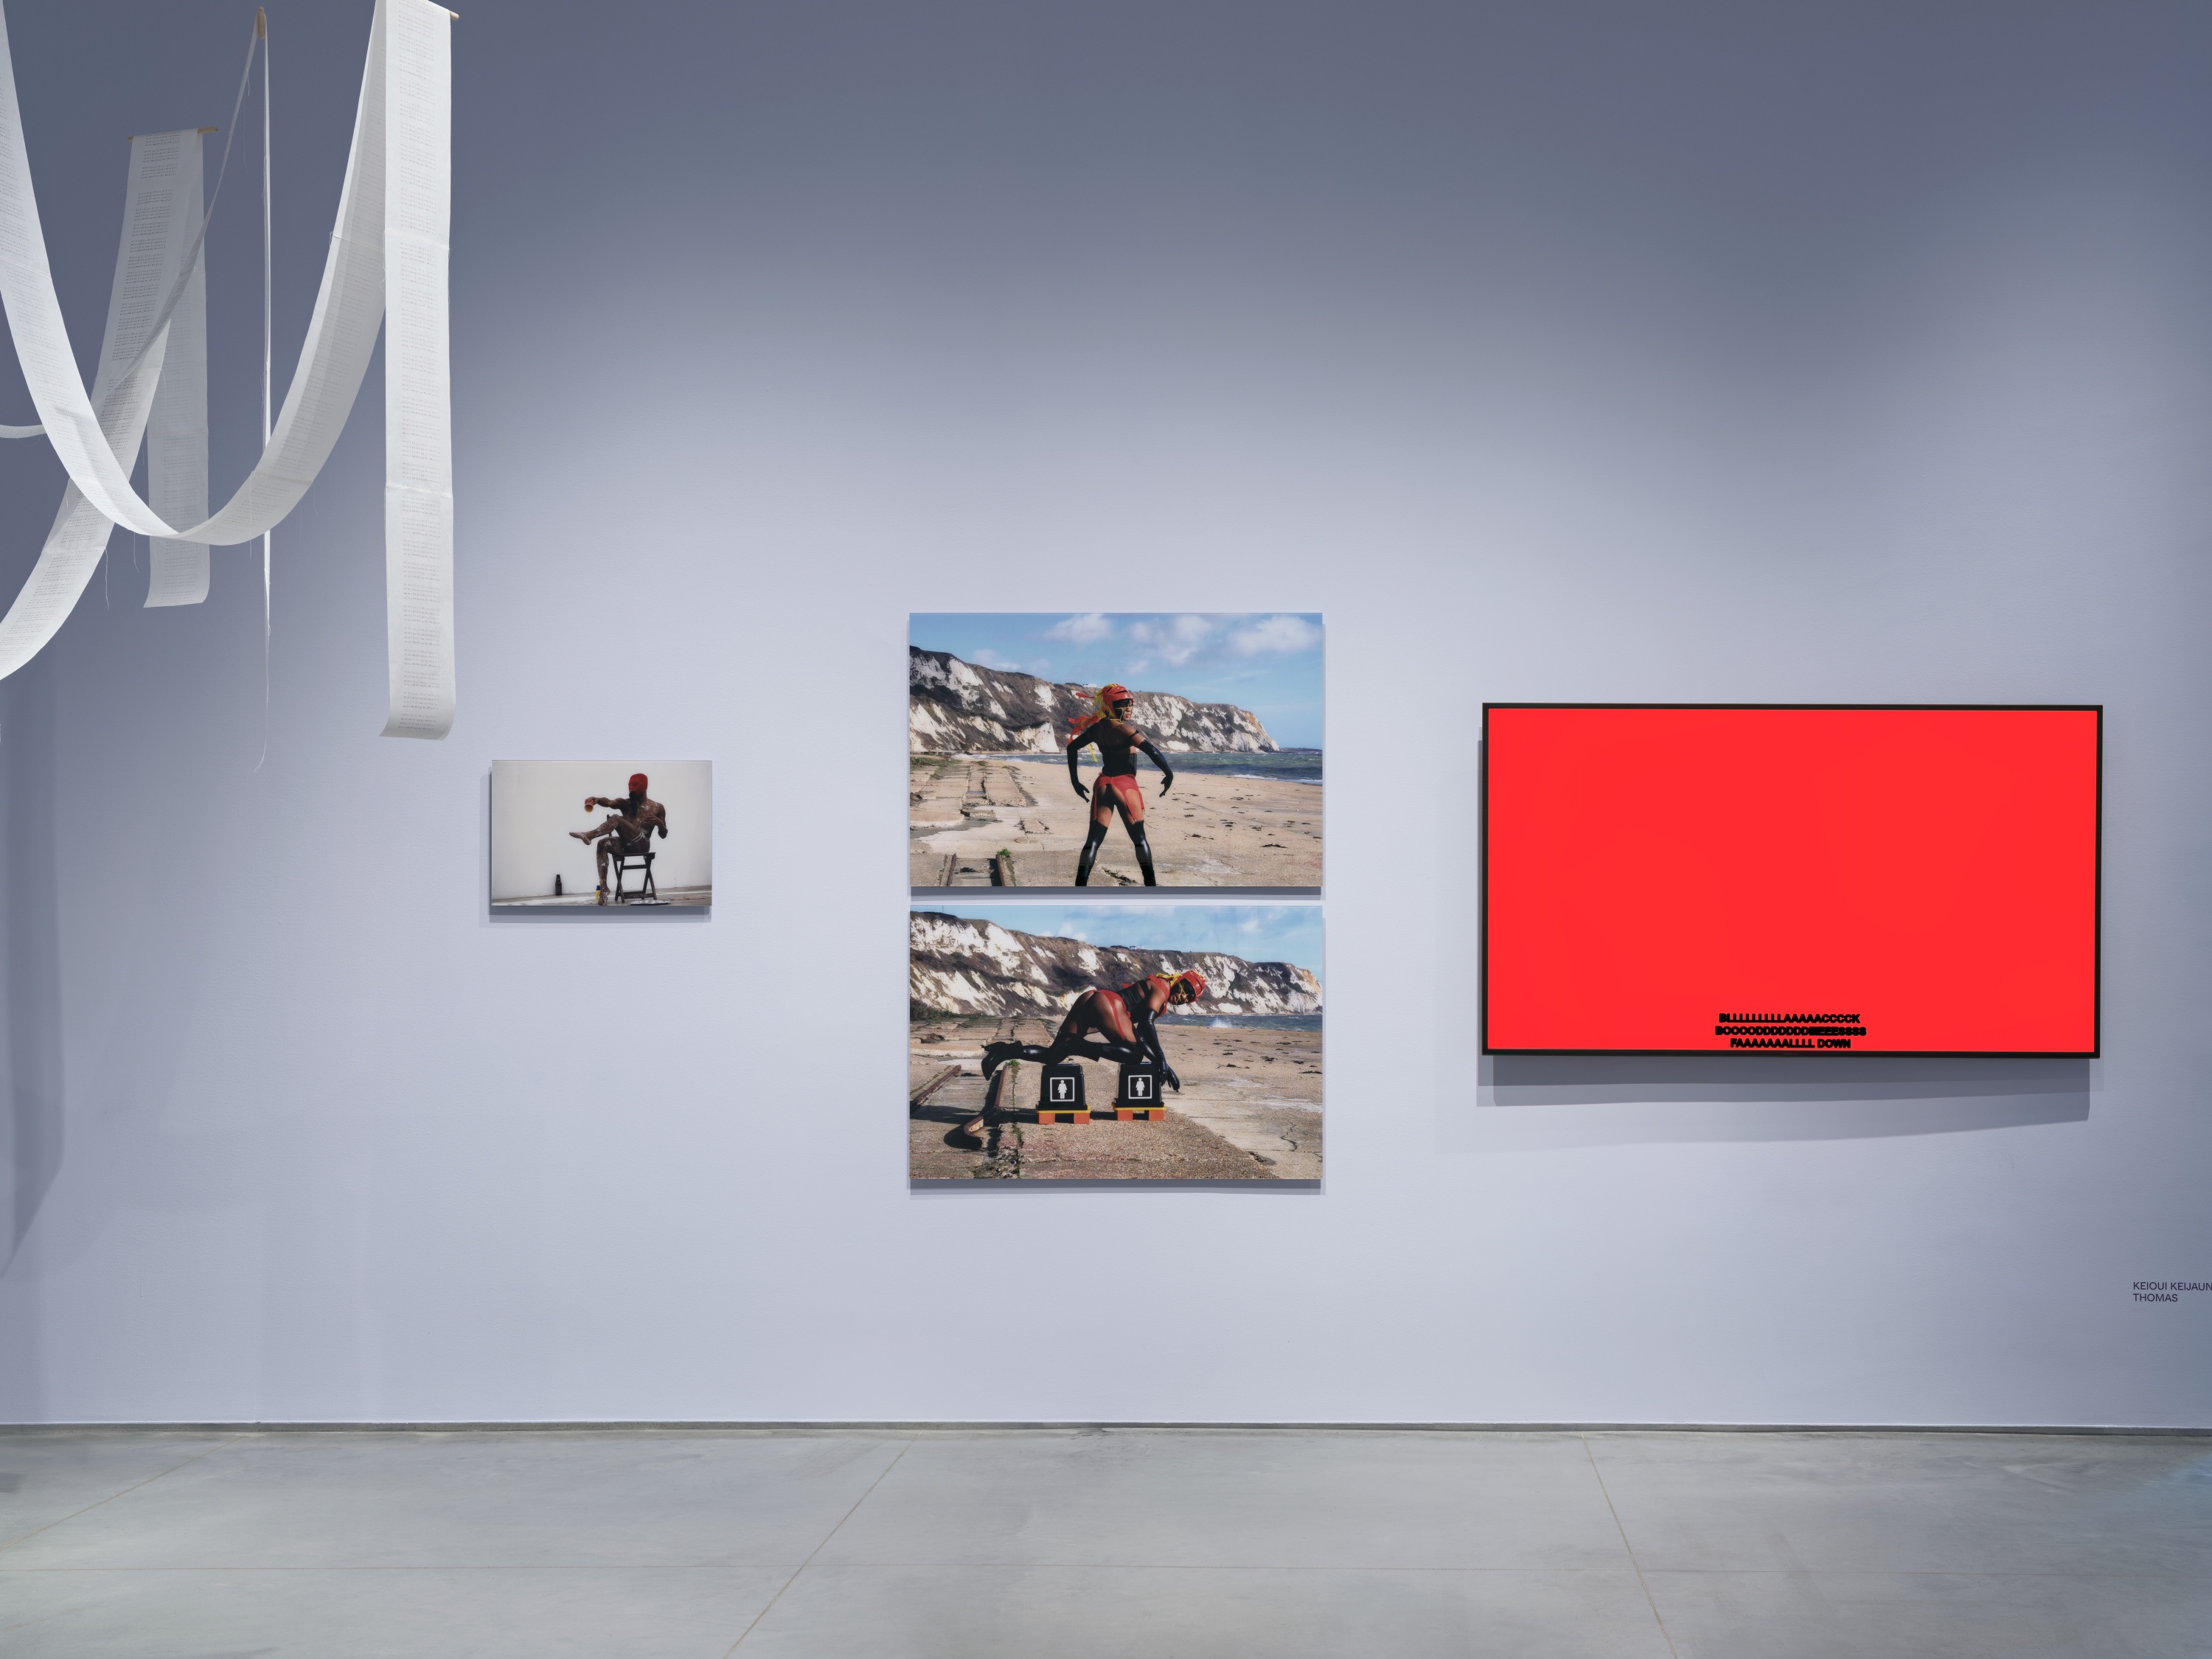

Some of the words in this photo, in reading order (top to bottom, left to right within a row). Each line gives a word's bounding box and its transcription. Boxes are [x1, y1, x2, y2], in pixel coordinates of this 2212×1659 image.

[1817, 1039, 1851, 1048] DOWN
[2133, 1281, 2167, 1290] KEIOUI
[2133, 1293, 2178, 1303] THOMAS
